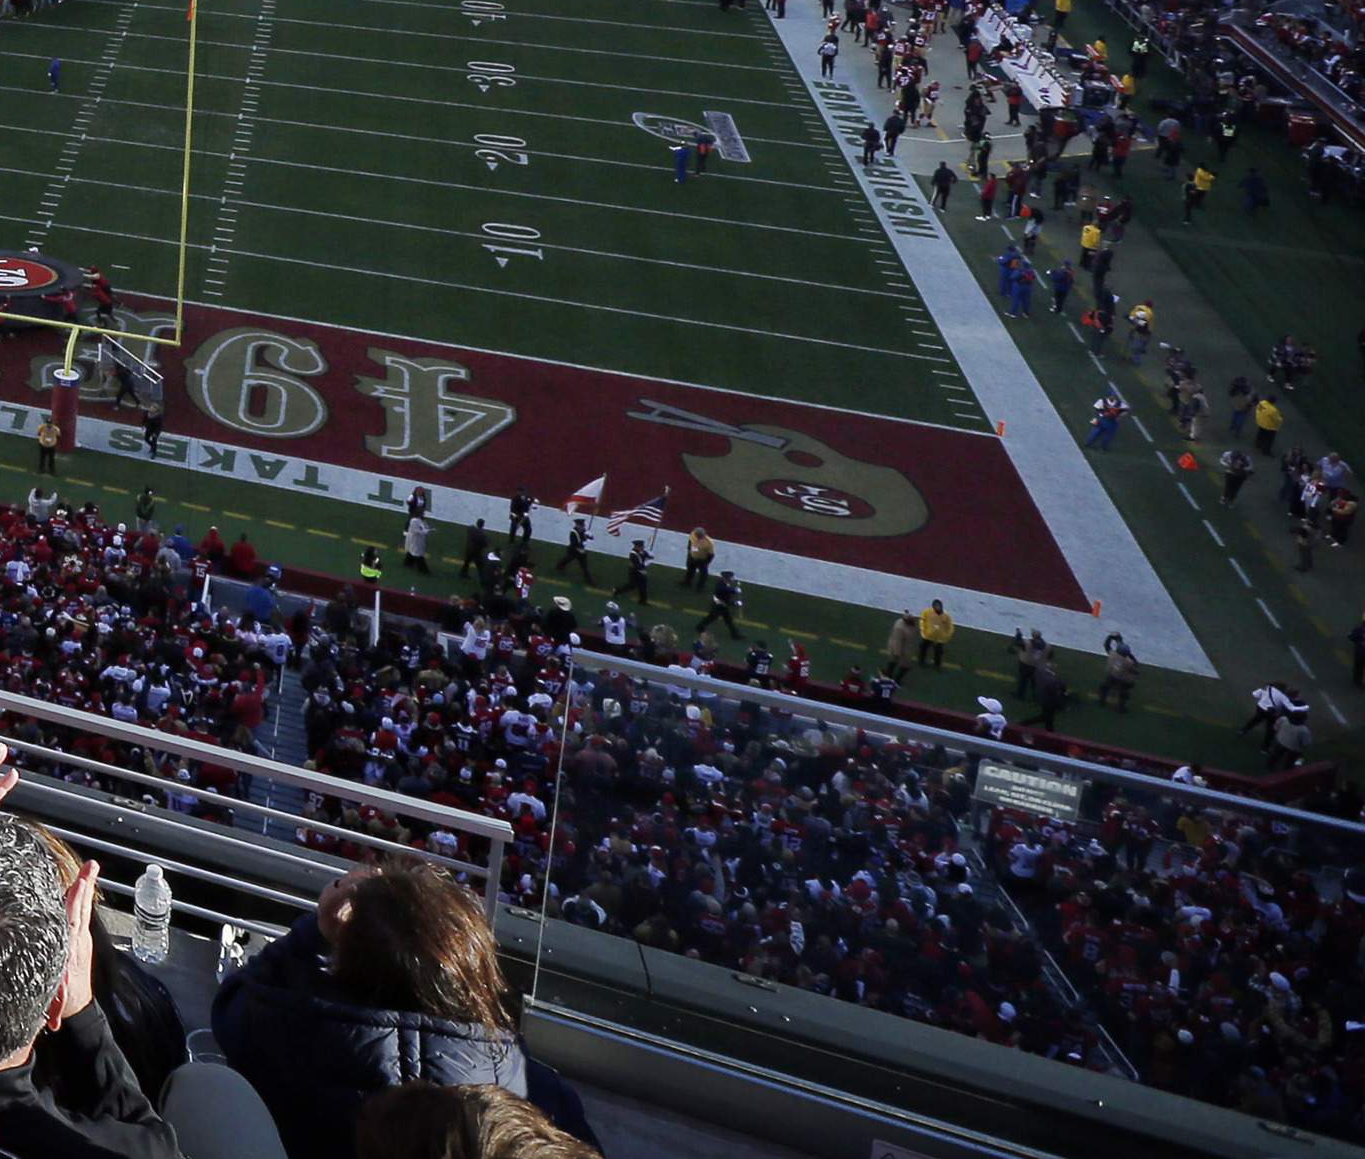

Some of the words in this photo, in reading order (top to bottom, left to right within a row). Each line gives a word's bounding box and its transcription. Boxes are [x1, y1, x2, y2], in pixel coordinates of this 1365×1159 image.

[813, 79, 873, 147] CHANGE
[854, 155, 939, 239] INSPIRE
[481, 222, 544, 262] 10
[107, 424, 331, 494] TAKES
[195, 566, 206, 577] 15
[611, 626, 619, 637] 4
[984, 765, 1078, 797] CAUTION
[308, 795, 324, 809] 97
